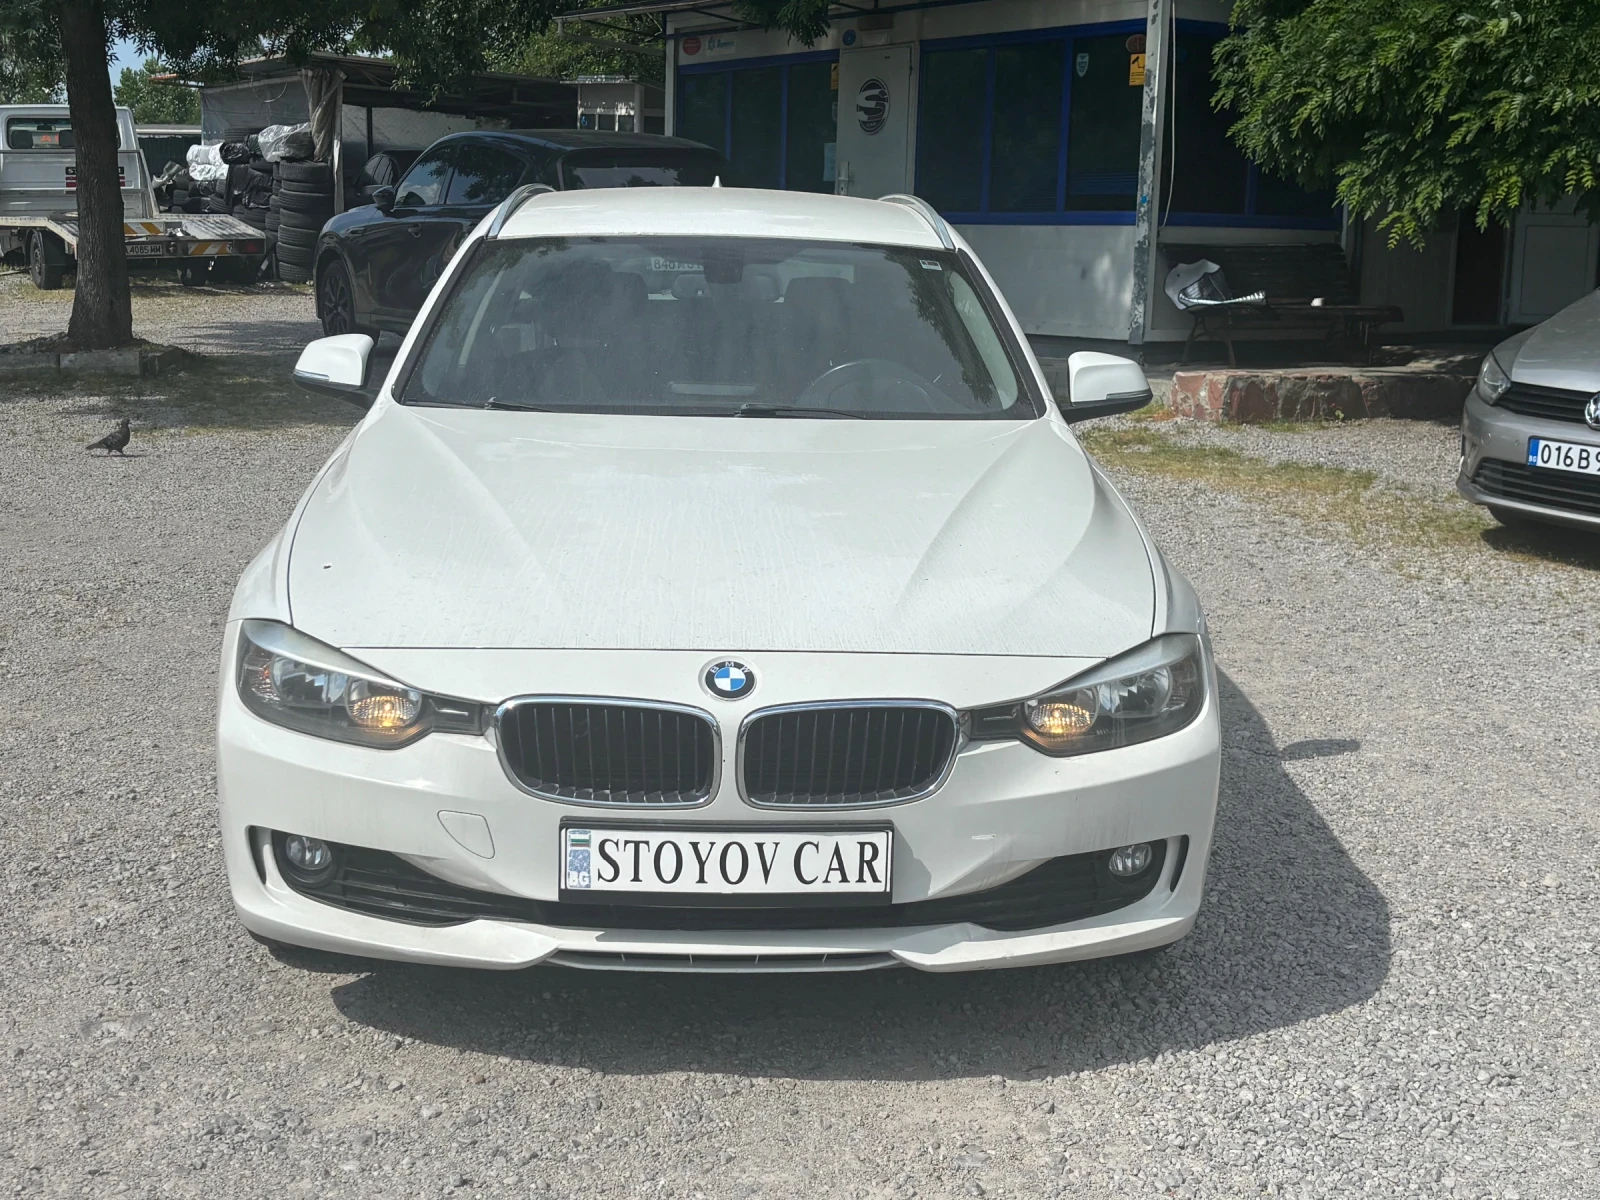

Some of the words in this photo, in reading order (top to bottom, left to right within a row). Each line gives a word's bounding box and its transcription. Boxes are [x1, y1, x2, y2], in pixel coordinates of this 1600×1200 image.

[709, 660, 751, 674] BMW
[597, 838, 781, 885] STOYOV
[793, 840, 882, 885] CAR
[569, 870, 590, 887] BG
